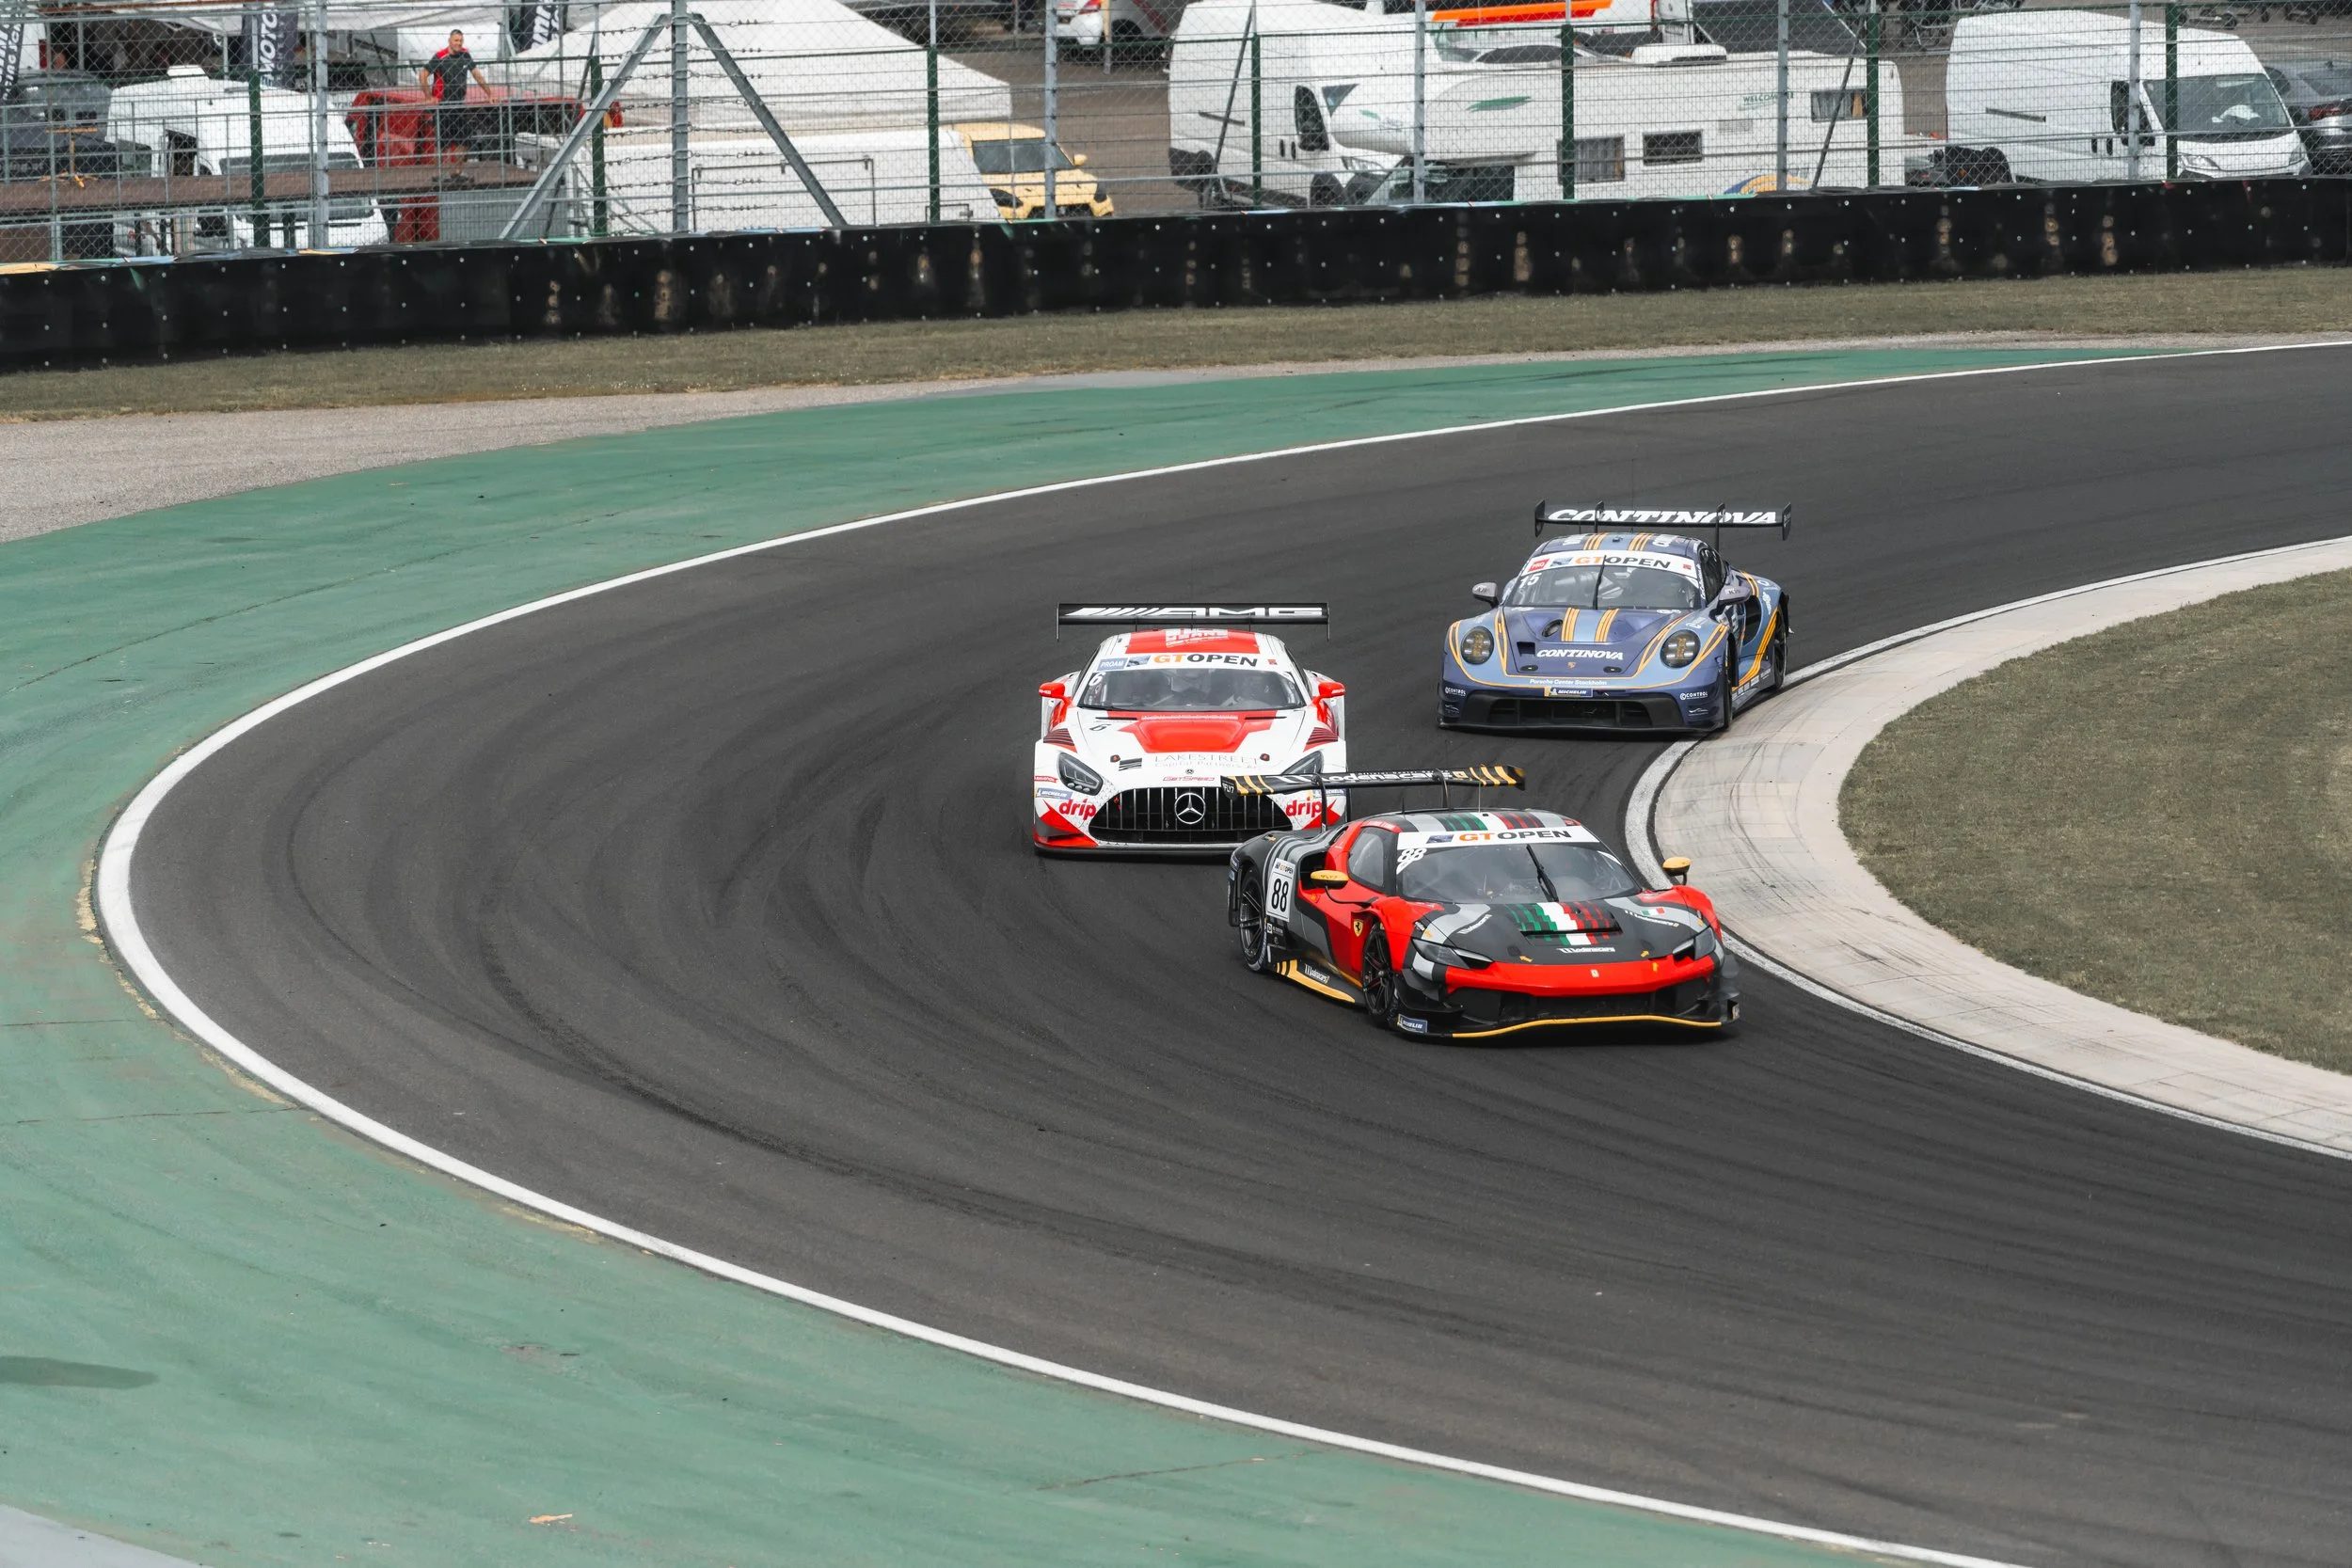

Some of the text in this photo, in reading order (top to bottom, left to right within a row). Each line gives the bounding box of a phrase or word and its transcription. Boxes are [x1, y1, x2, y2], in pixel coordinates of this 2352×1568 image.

[1742, 93, 1781, 103] WELCOM
[1548, 509, 1776, 524] CONTINOVA
[1519, 573, 1542, 589] 15
[1536, 649, 1624, 660] CONTINOVA
[1100, 659, 1124, 668] PROAM
[1089, 672, 1105, 686] 6
[1058, 799, 1097, 821] drip
[1285, 796, 1323, 817] drip
[1397, 848, 1427, 863] 88
[1271, 878, 1289, 912] 88
